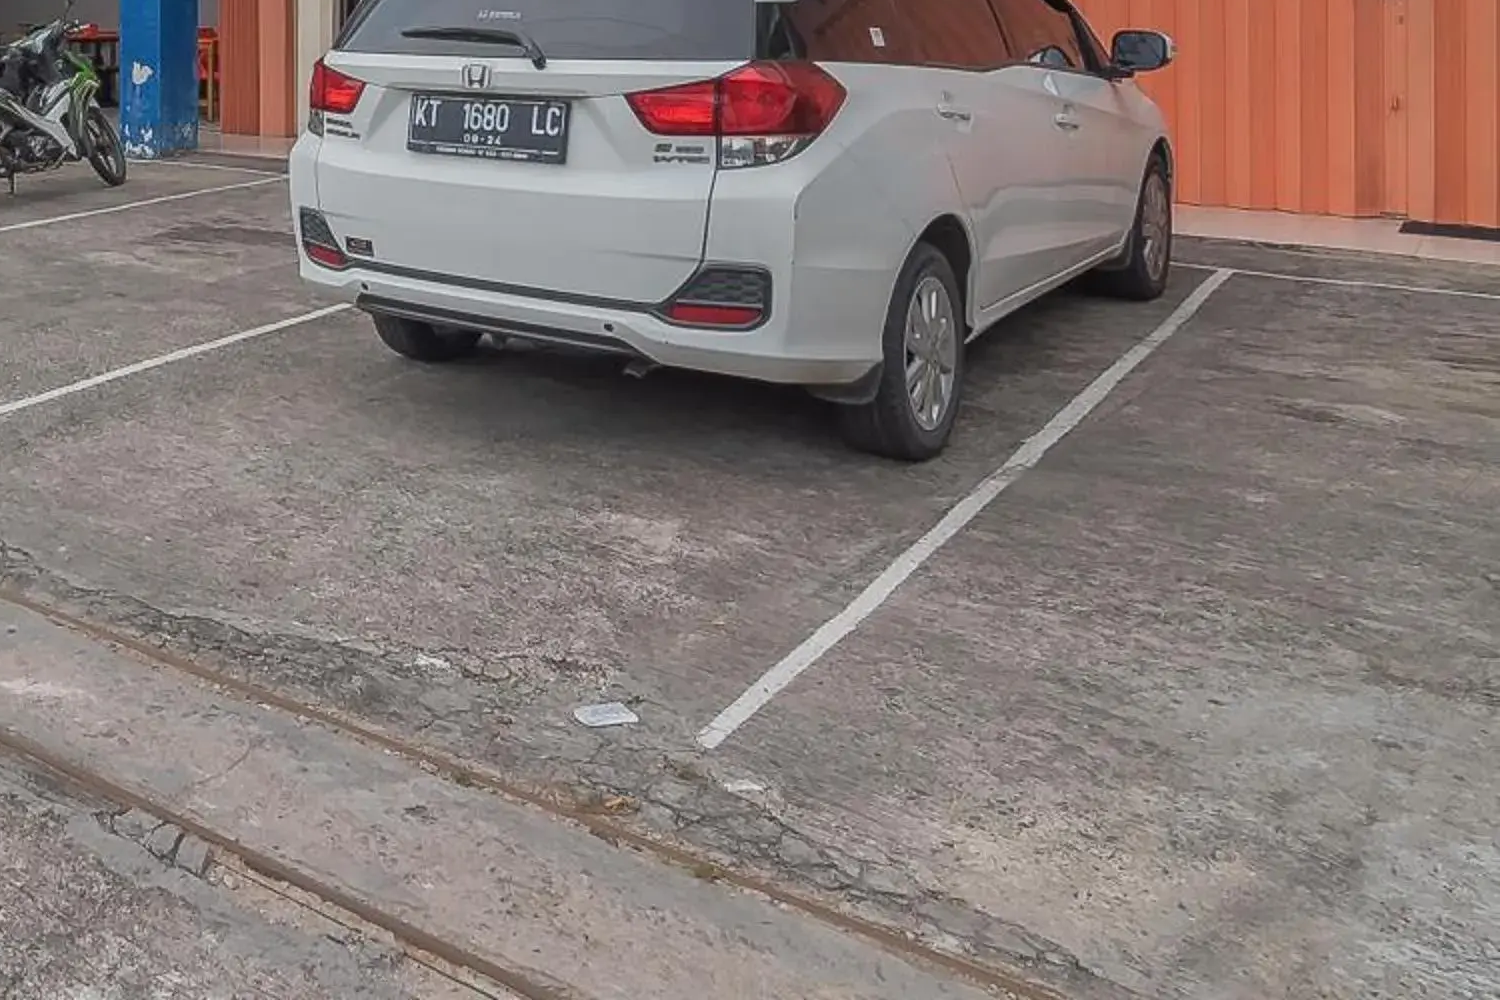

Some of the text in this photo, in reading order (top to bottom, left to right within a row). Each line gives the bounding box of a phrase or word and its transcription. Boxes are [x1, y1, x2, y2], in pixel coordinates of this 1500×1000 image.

[414, 100, 561, 136] KT 1680 LC
